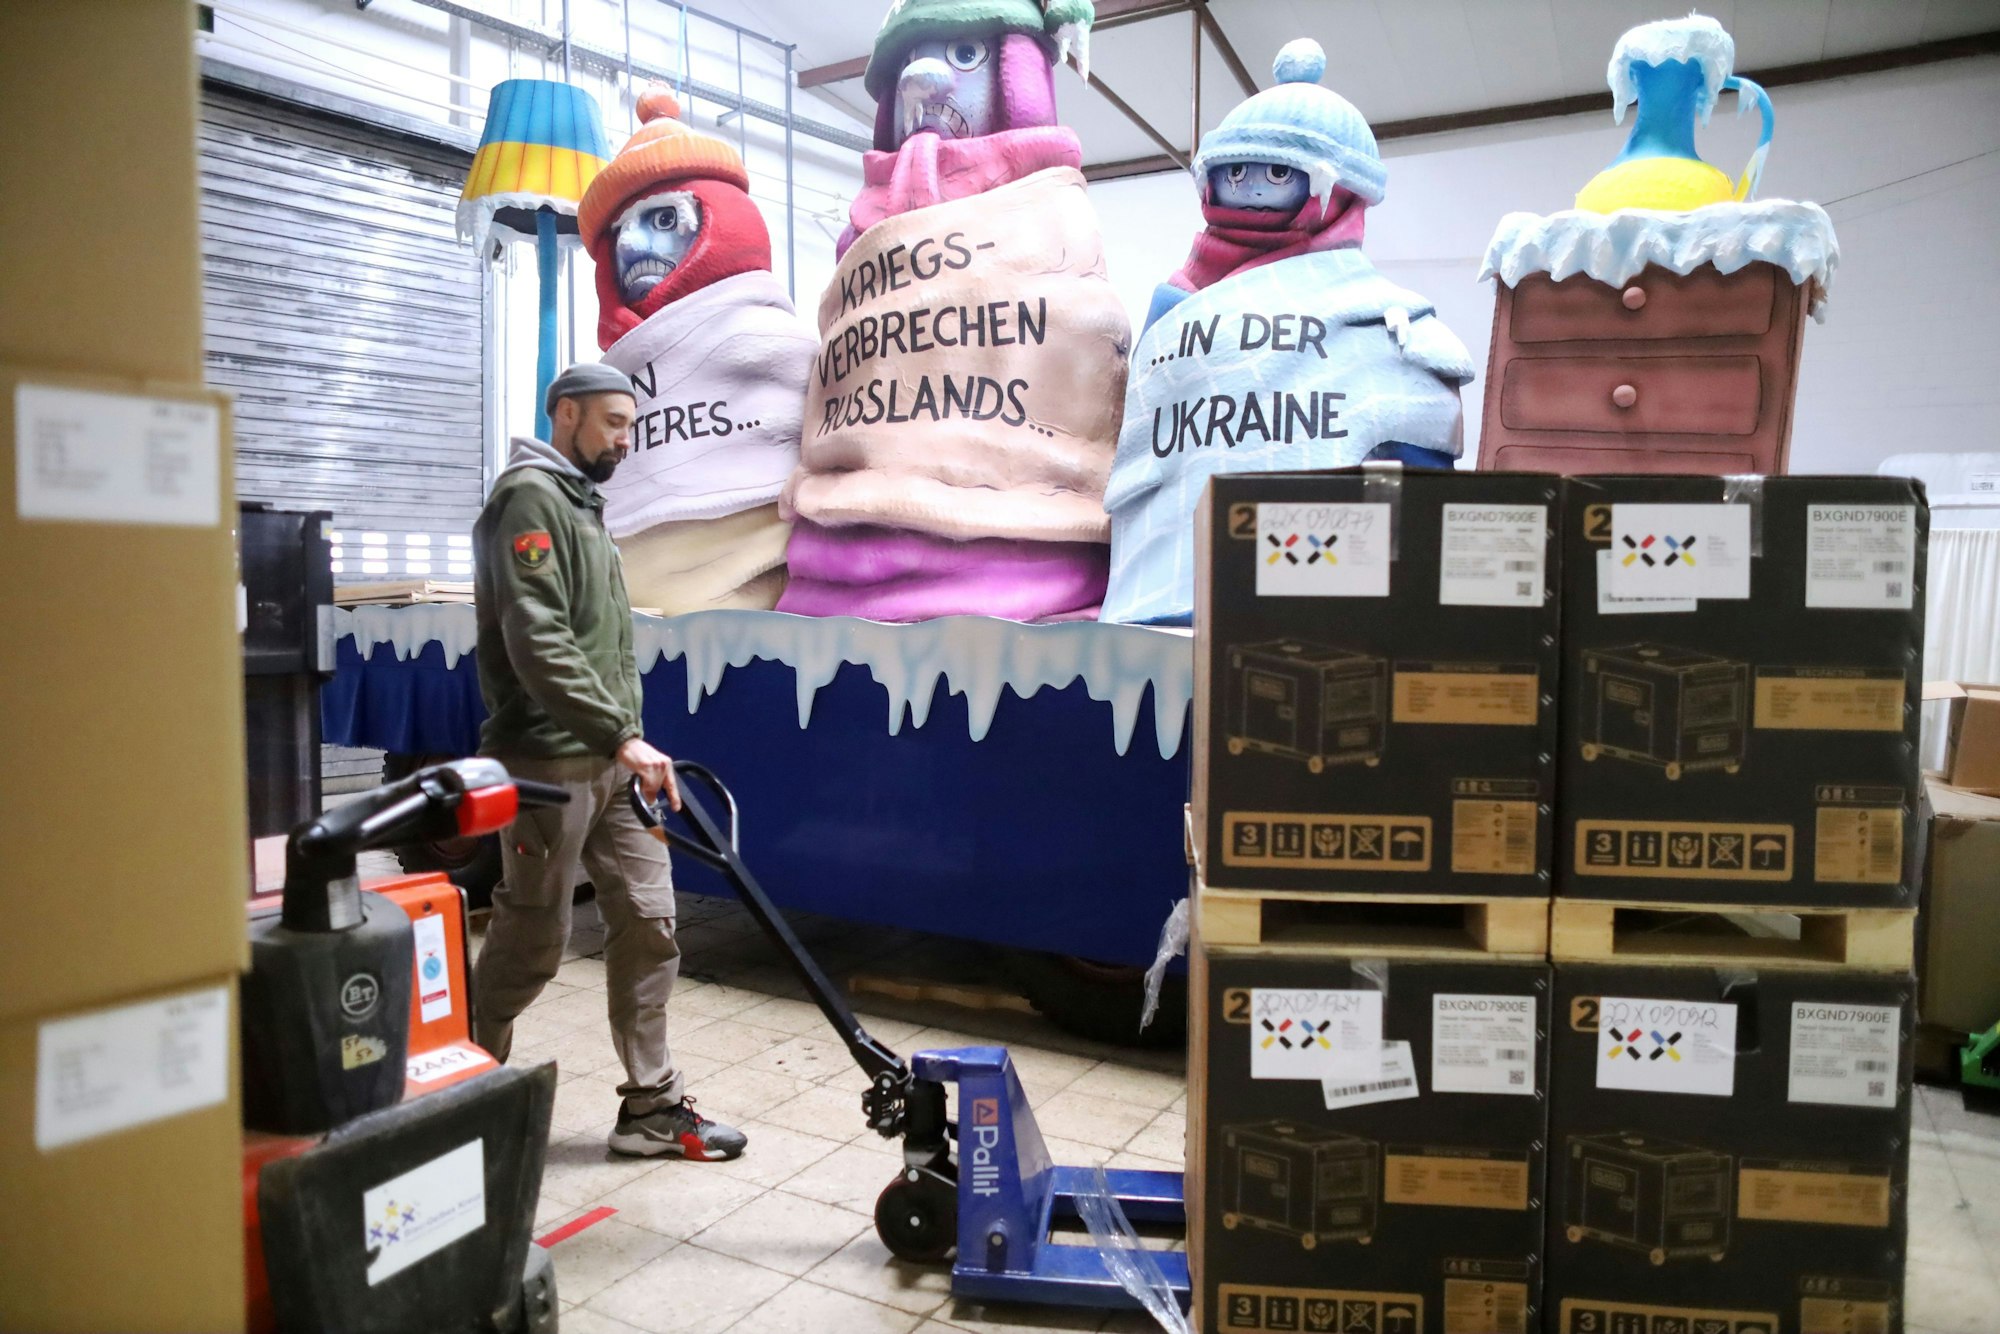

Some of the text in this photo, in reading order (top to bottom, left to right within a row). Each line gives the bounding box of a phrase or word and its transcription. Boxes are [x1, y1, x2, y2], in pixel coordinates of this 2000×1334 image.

[818, 296, 1047, 388] VERBRECHEN
[1151, 313, 1329, 367] ...IN DER
[630, 361, 657, 399] N
[816, 374, 1055, 439] RUSSLANDS...
[632, 400, 761, 453] TERES...
[1152, 391, 1348, 458] UKRAINE
[1233, 506, 1256, 534] 2
[1447, 510, 1538, 523] BXGND7900E
[1590, 507, 1612, 537] 2
[1813, 510, 1908, 522] BXGND7900E
[1229, 991, 1250, 1018] 2
[1439, 1000, 1528, 1012] BXGND7900E
[1576, 1000, 1599, 1028] 2
[1797, 1008, 1890, 1023] BXGND7900E
[973, 1126, 999, 1197] Pallit
